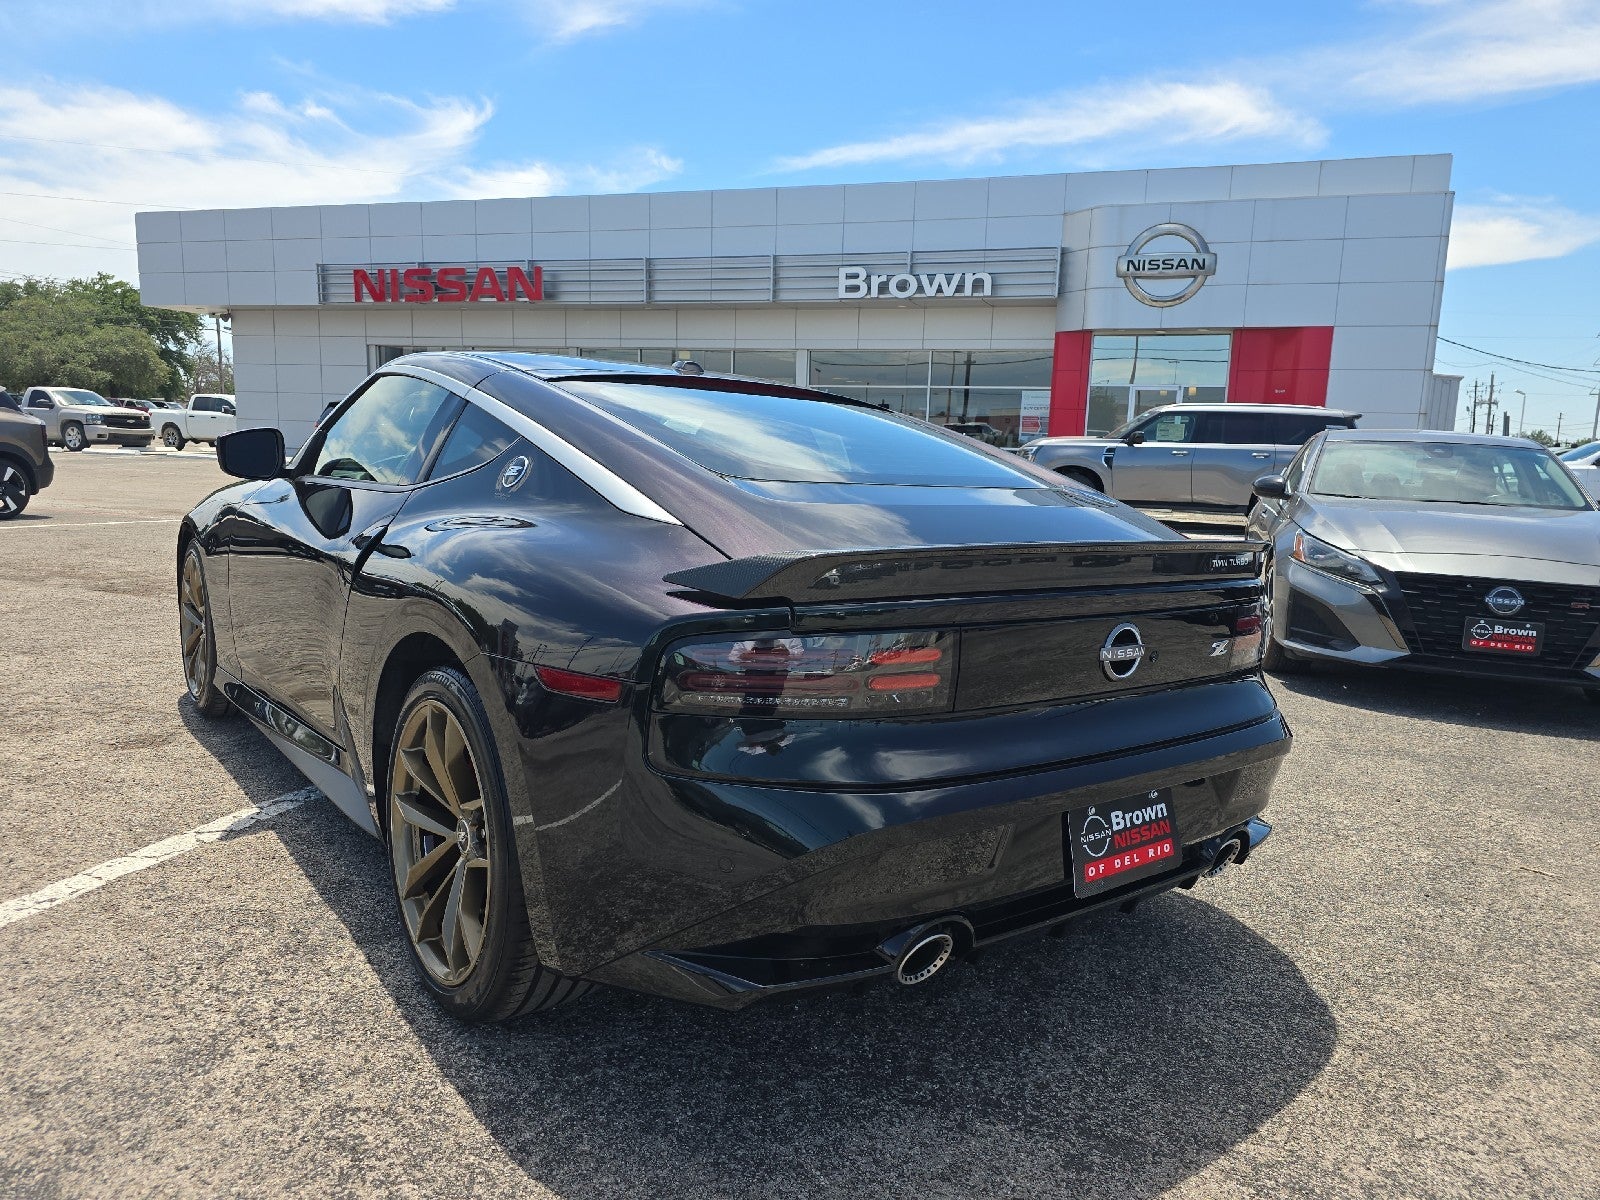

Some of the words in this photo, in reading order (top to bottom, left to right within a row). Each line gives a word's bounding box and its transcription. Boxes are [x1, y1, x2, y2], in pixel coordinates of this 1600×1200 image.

[1126, 257, 1206, 272] NISSAN
[353, 266, 544, 303] NISSAN
[838, 266, 993, 299] Brown
[1229, 557, 1249, 566] TURBO
[1485, 597, 1525, 606] NISSAN
[1492, 633, 1537, 643] NISSAN
[1494, 624, 1537, 637] Brown
[1102, 646, 1145, 659] NISSAN
[1110, 802, 1167, 831] Brown
[1080, 828, 1112, 844] NISSAN
[1113, 820, 1170, 848] NISSAN
[1088, 863, 1105, 877] OF
[1115, 854, 1139, 868] DEL
[1148, 844, 1170, 857] RIO
